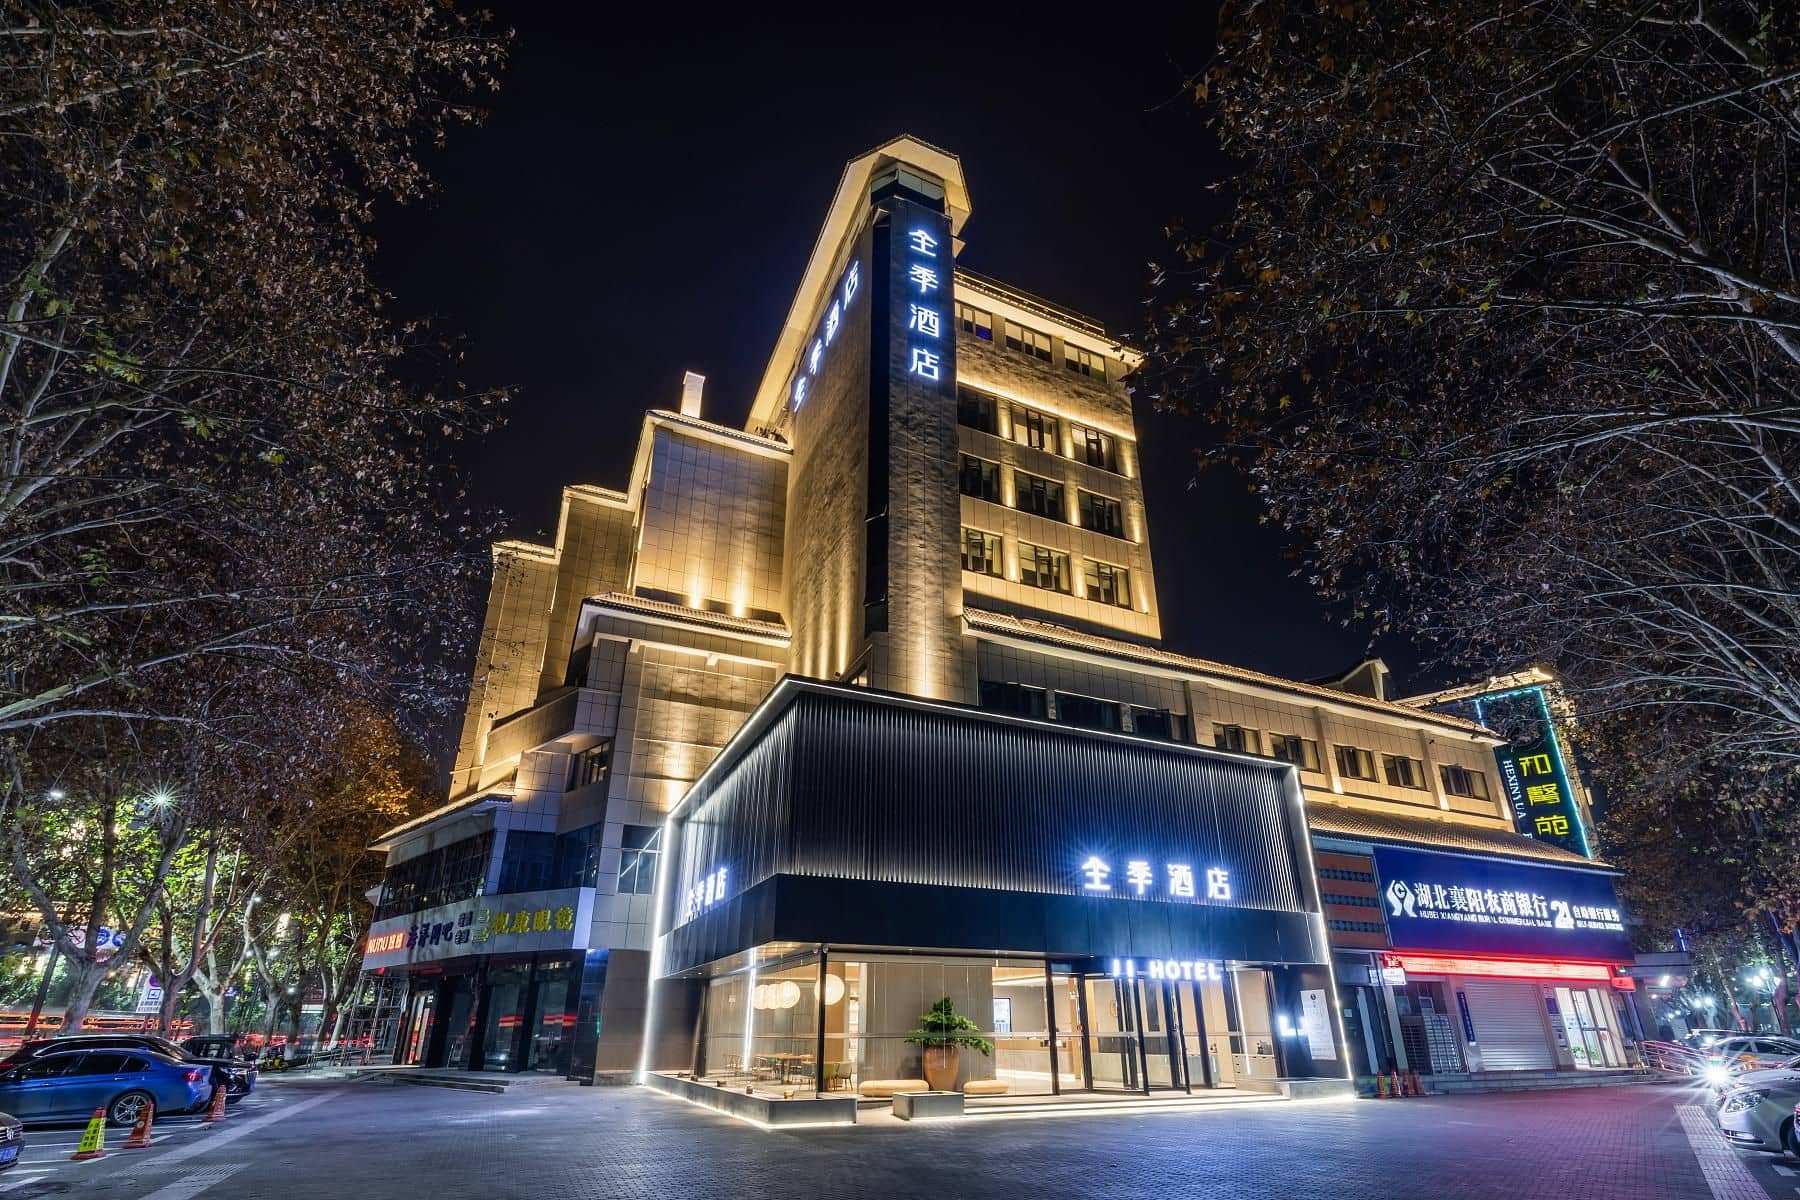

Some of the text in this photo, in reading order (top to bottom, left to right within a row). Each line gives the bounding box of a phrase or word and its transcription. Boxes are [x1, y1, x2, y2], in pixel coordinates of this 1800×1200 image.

[908, 229, 940, 381] 全季酒店
[1518, 753, 1570, 836] 和馨苑
[1081, 856, 1232, 900] 全季酒店
[1413, 882, 1549, 918] 湖北襄阳农商银行
[1149, 959, 1222, 981] HOTEL
